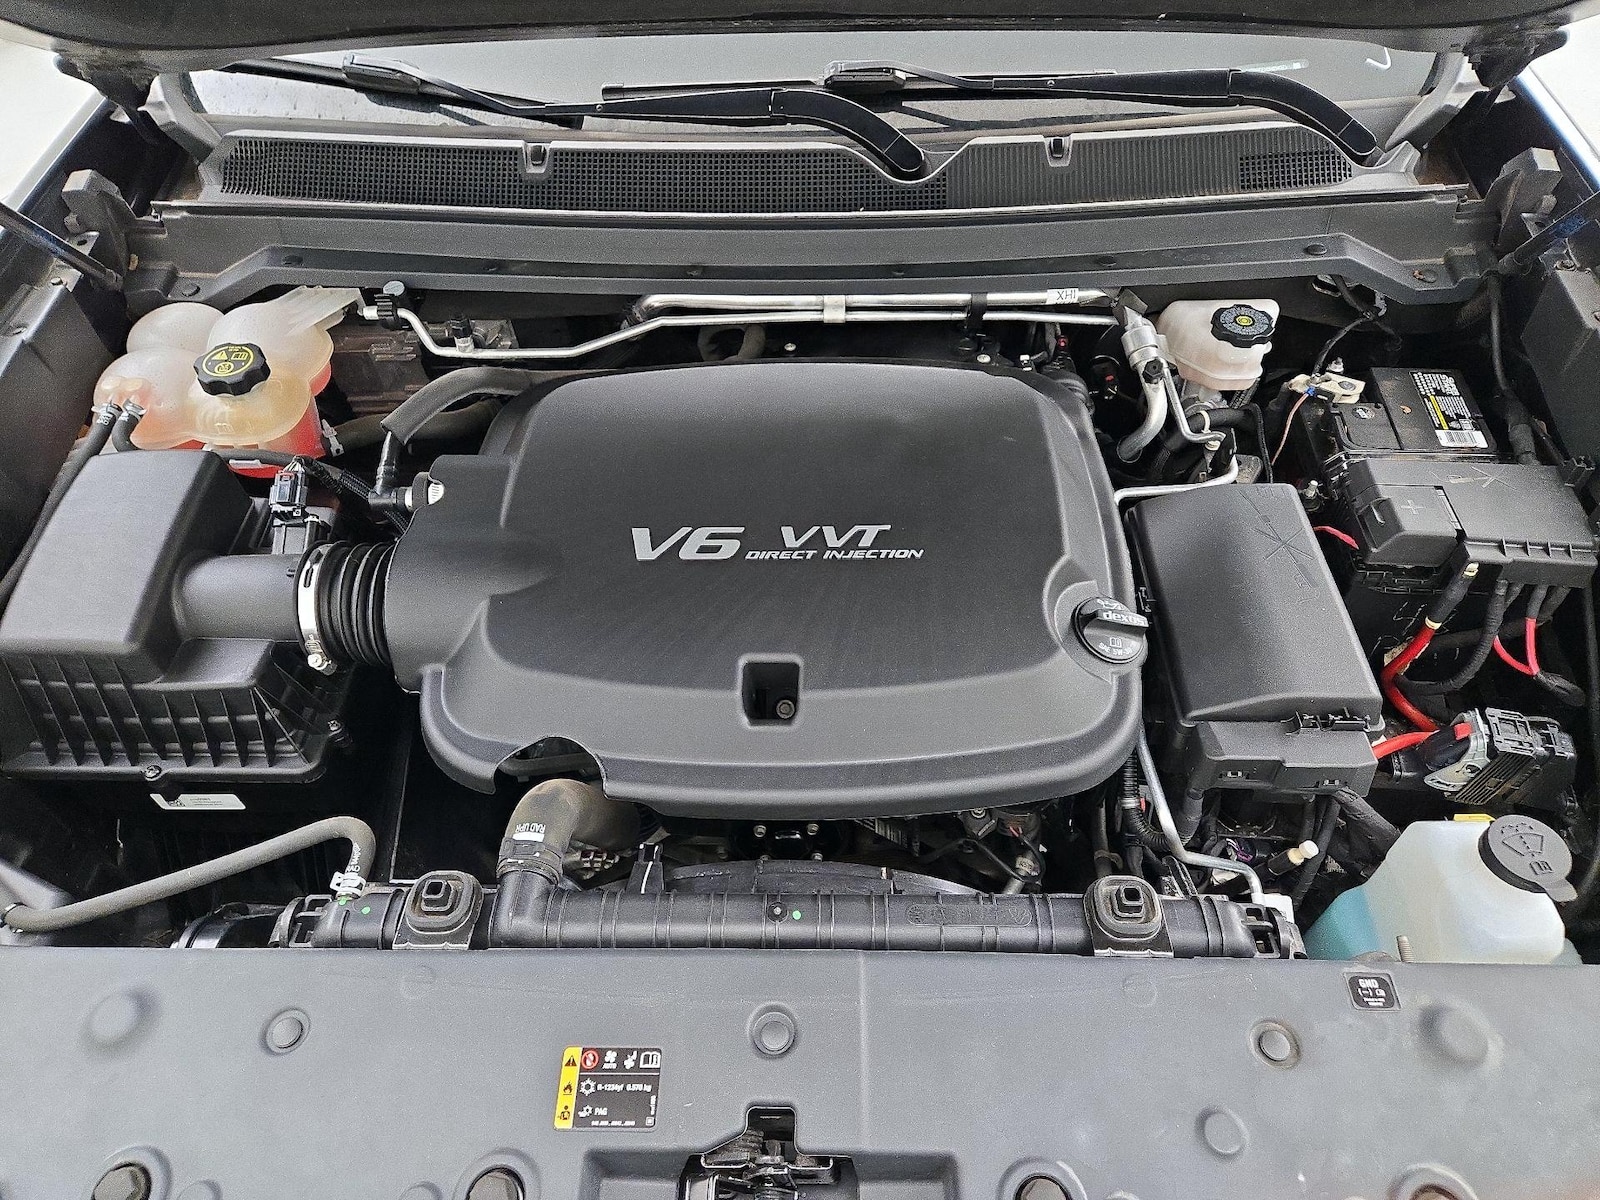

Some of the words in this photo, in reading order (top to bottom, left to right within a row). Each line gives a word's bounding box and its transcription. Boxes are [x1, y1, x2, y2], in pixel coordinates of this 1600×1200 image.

[632, 526, 745, 561] V6
[781, 524, 892, 548] VVT
[745, 550, 818, 560] DIRECT
[822, 549, 925, 560] INJECTION
